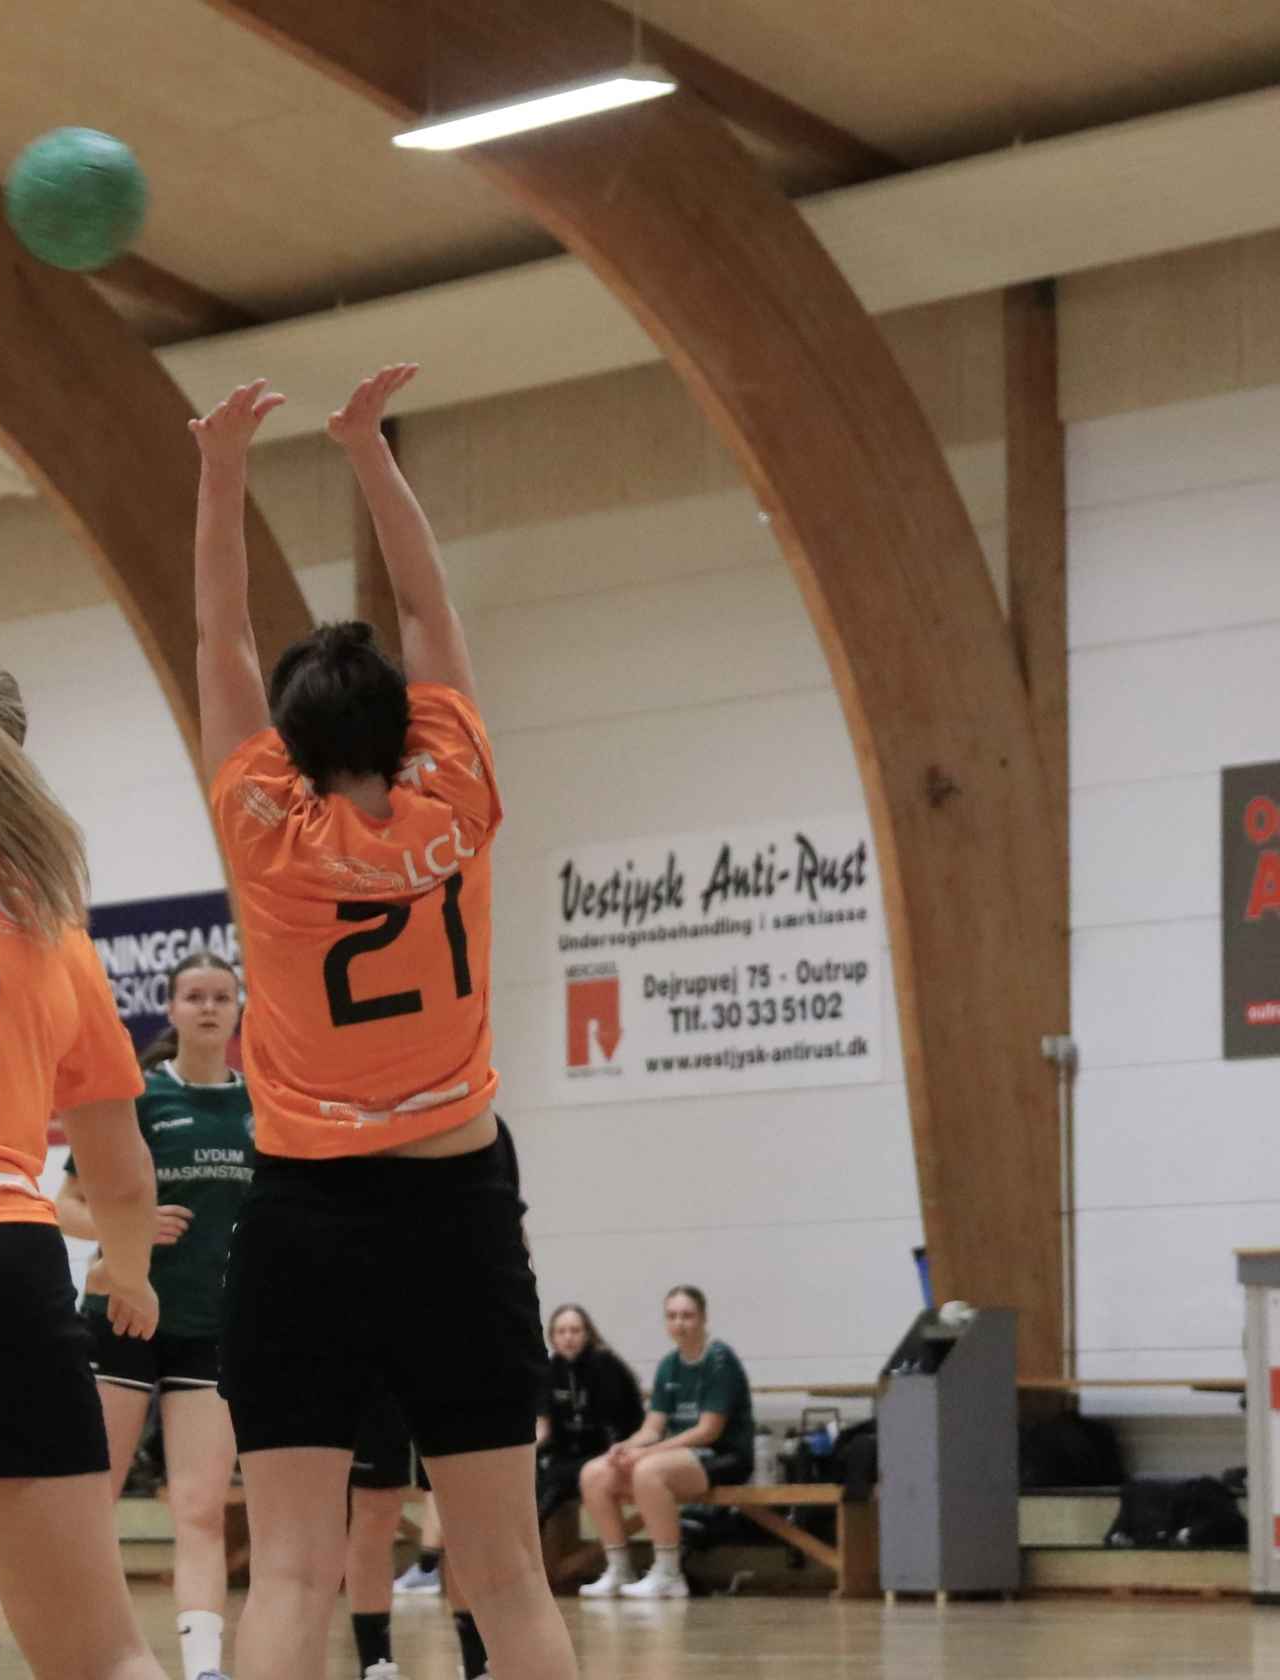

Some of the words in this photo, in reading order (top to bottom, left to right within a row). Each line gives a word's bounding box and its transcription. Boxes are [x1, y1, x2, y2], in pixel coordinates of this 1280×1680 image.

[1244, 797, 1280, 843] O
[558, 851, 684, 927] Vestjysk
[701, 832, 867, 915] Anti-Rust
[323, 871, 473, 1028] 21
[643, 966, 738, 1000] Dejrupvej
[746, 963, 771, 989] 75
[795, 958, 867, 986] Outrup
[669, 1004, 709, 1034] Tlf.
[194, 1148, 244, 1163] LYDUM
